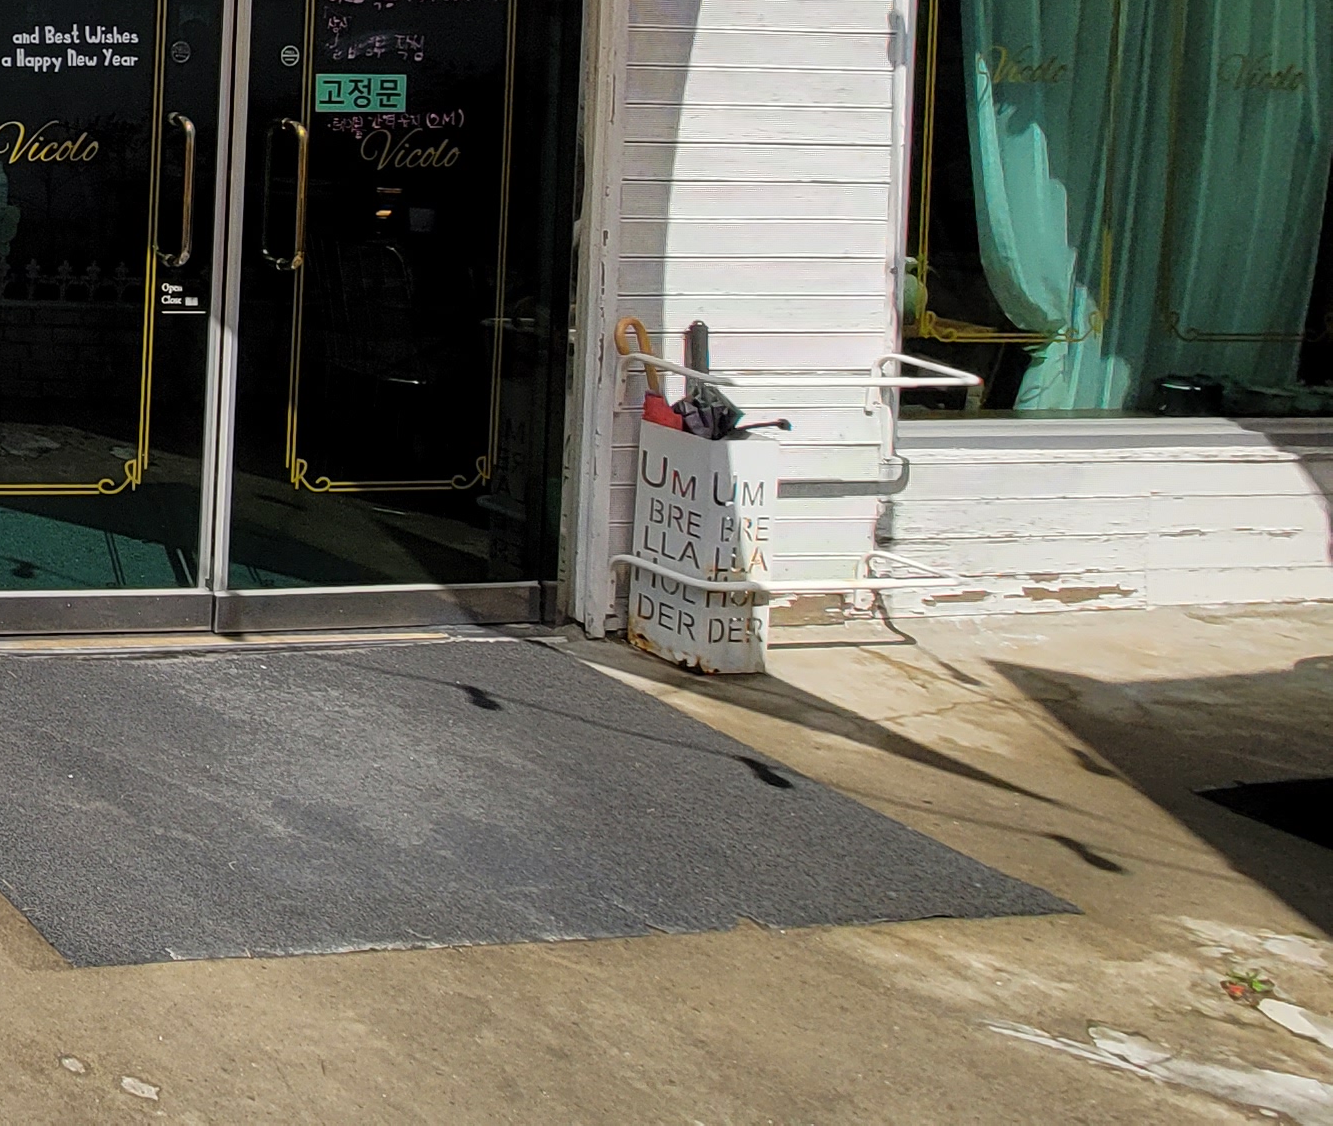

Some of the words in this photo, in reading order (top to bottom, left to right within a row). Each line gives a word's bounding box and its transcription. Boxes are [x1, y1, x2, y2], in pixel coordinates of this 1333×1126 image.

[12, 25, 40, 44] and
[44, 23, 81, 44] Best
[85, 25, 139, 44] Wishes
[1, 56, 12, 67] a
[16, 48, 62, 72] Happy
[67, 48, 97, 67] New
[102, 48, 139, 67] Year
[319, 78, 402, 109] 고정문
[361, 128, 461, 170] Vicolo
[161, 282, 183, 294] Open
[641, 450, 697, 501] UM
[649, 497, 702, 539] BRE
[643, 525, 700, 569] LLA
[637, 593, 696, 641] DER
